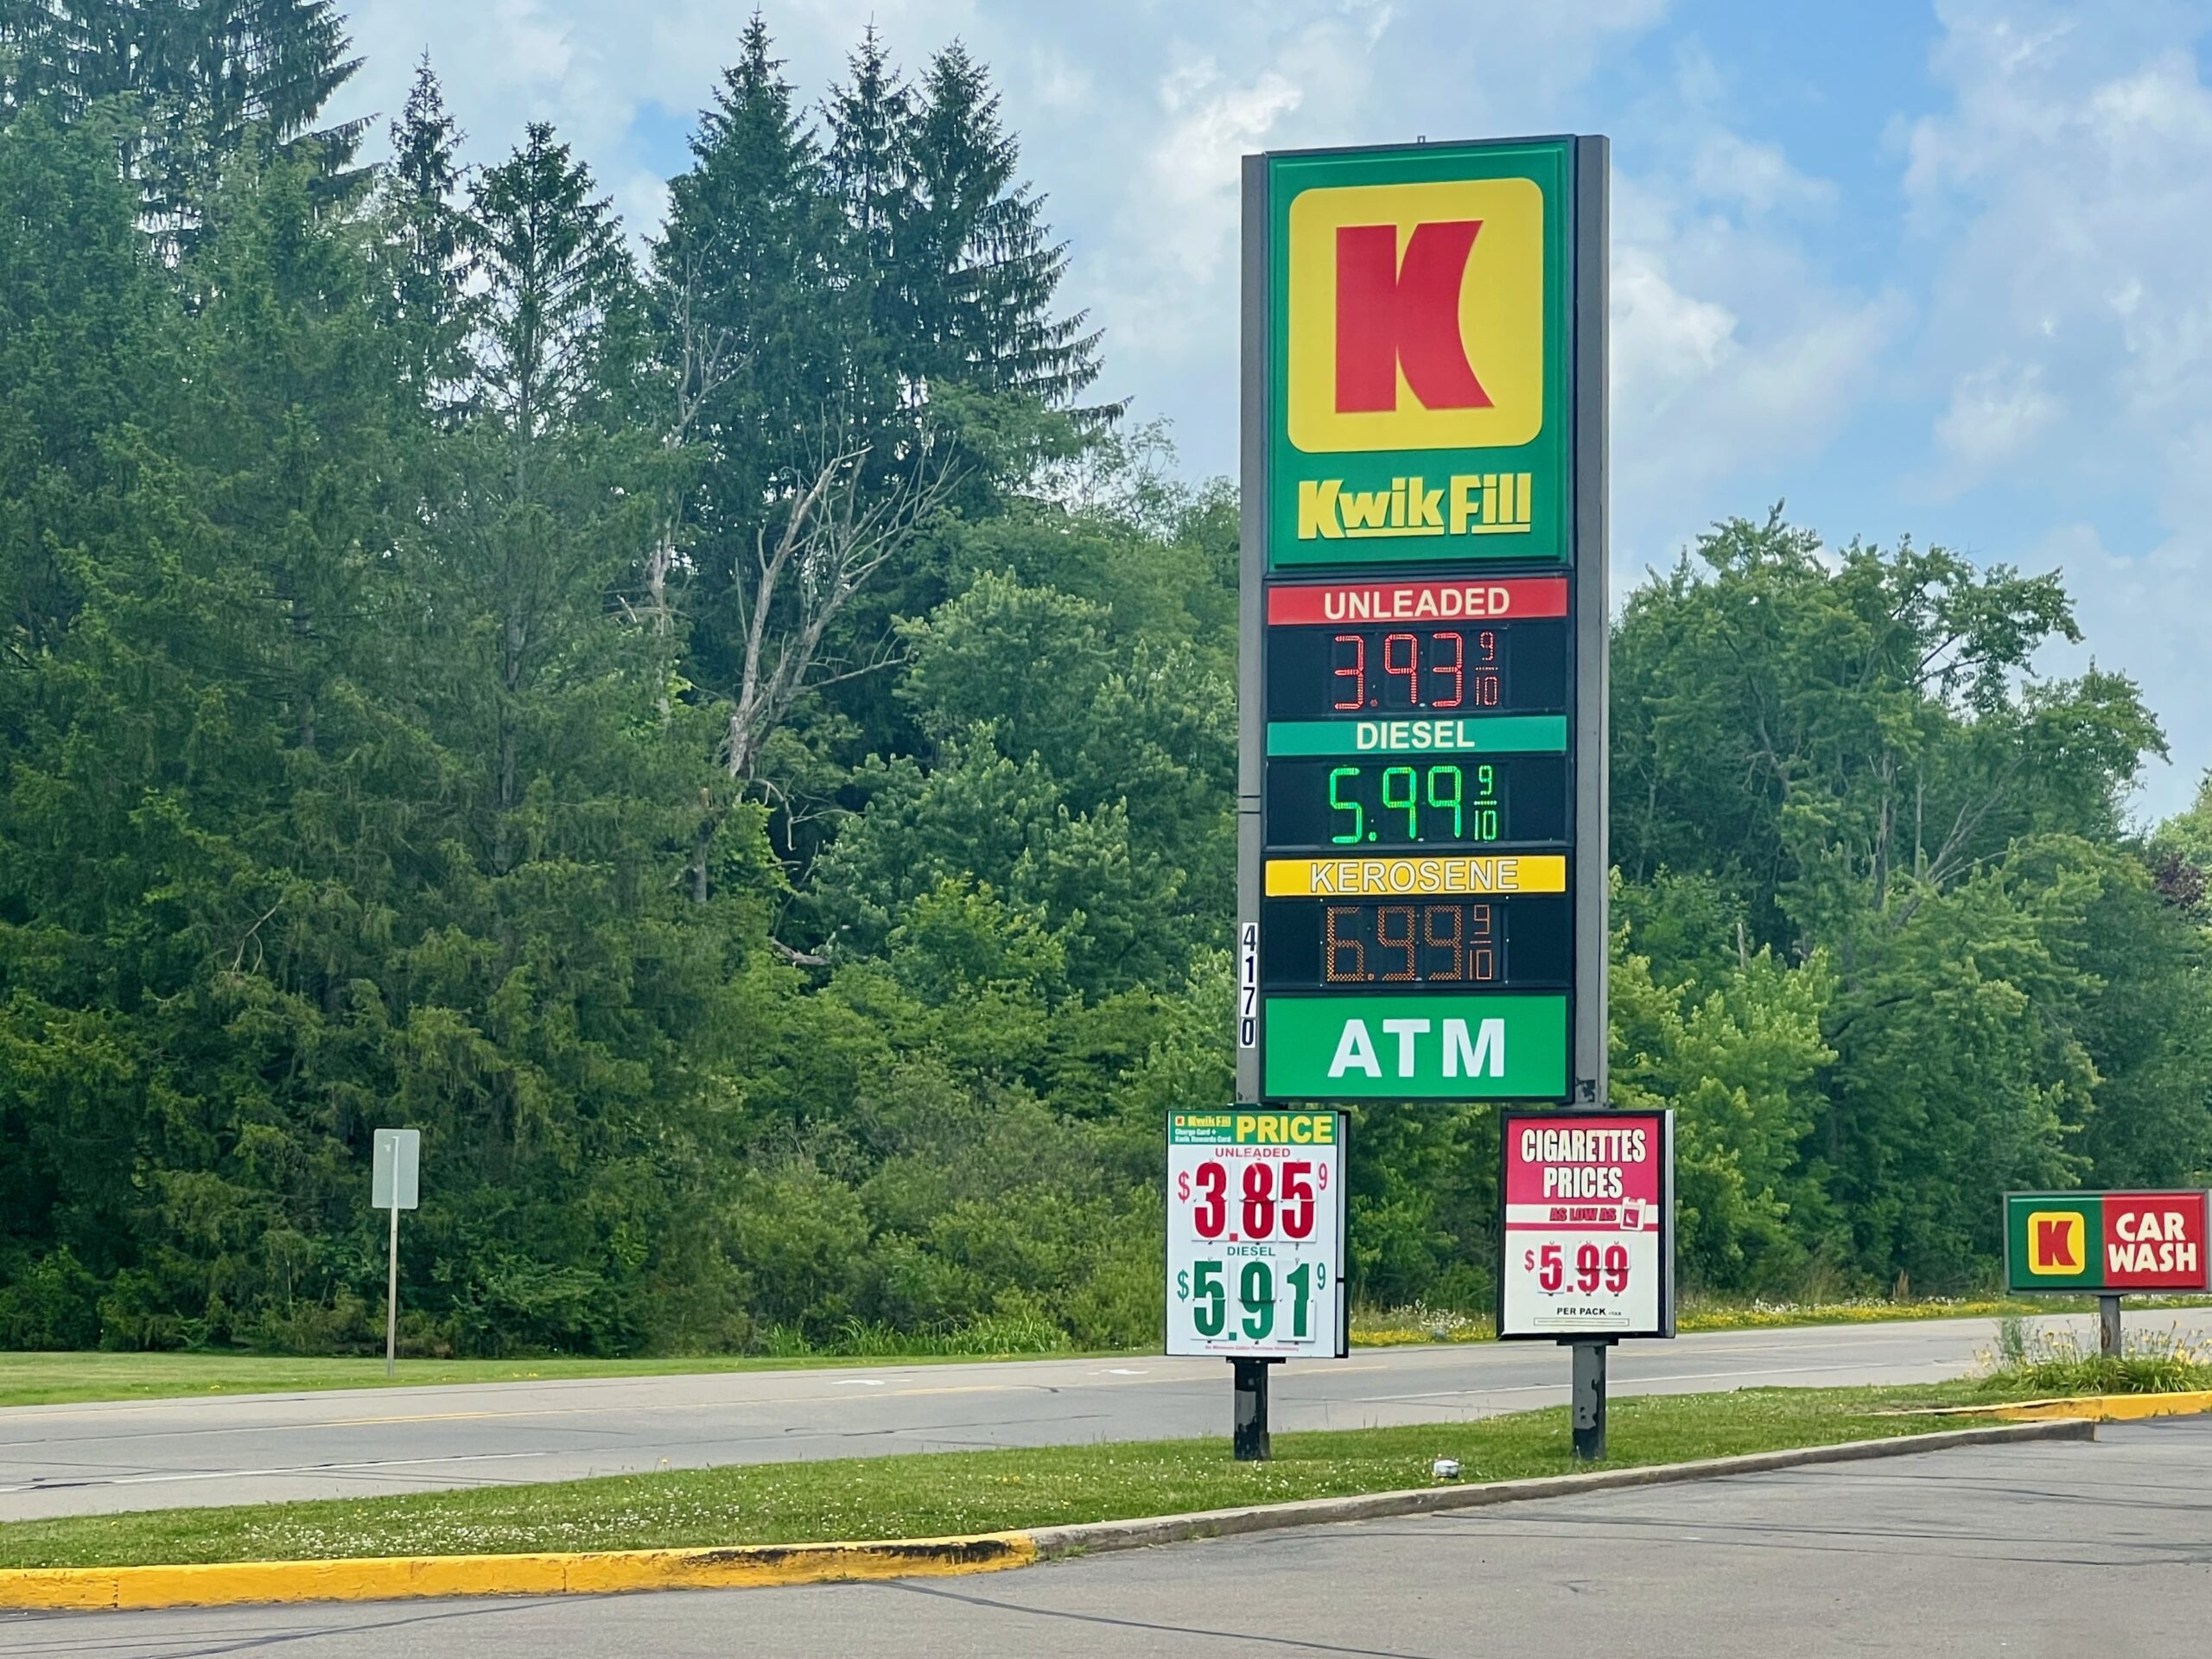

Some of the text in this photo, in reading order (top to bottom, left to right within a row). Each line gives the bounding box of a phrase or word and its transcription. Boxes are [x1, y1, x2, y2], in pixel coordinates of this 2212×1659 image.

[1335, 219, 1496, 414] K
[1298, 473, 1532, 540] Kwik Fill
[1324, 587, 1510, 620] UNLEADED
[1334, 632, 1464, 710] 3.93
[1356, 721, 1476, 751] DIESEL
[1329, 765, 1462, 844] 5.99
[1310, 859, 1520, 893] KEROSENE
[1326, 905, 1463, 982] 6.99
[1241, 925, 1257, 1046] 4170
[1327, 1018, 1505, 1077] ATM
[1236, 1116, 1333, 1144] PRICE
[1521, 1128, 1647, 1163] CIGARETTES
[1215, 1147, 1291, 1158] UNLEADED
[1542, 1166, 1624, 1199] PRICES
[1549, 1207, 1617, 1222] AS LOW AS
[2115, 1212, 2187, 1242] CAR
[1227, 1246, 1276, 1257] DIESEL
[2037, 1220, 2078, 1267] K
[2107, 1243, 2197, 1273] WASH
[1556, 1306, 1577, 1316] PER
[1580, 1307, 1606, 1316] PACK
